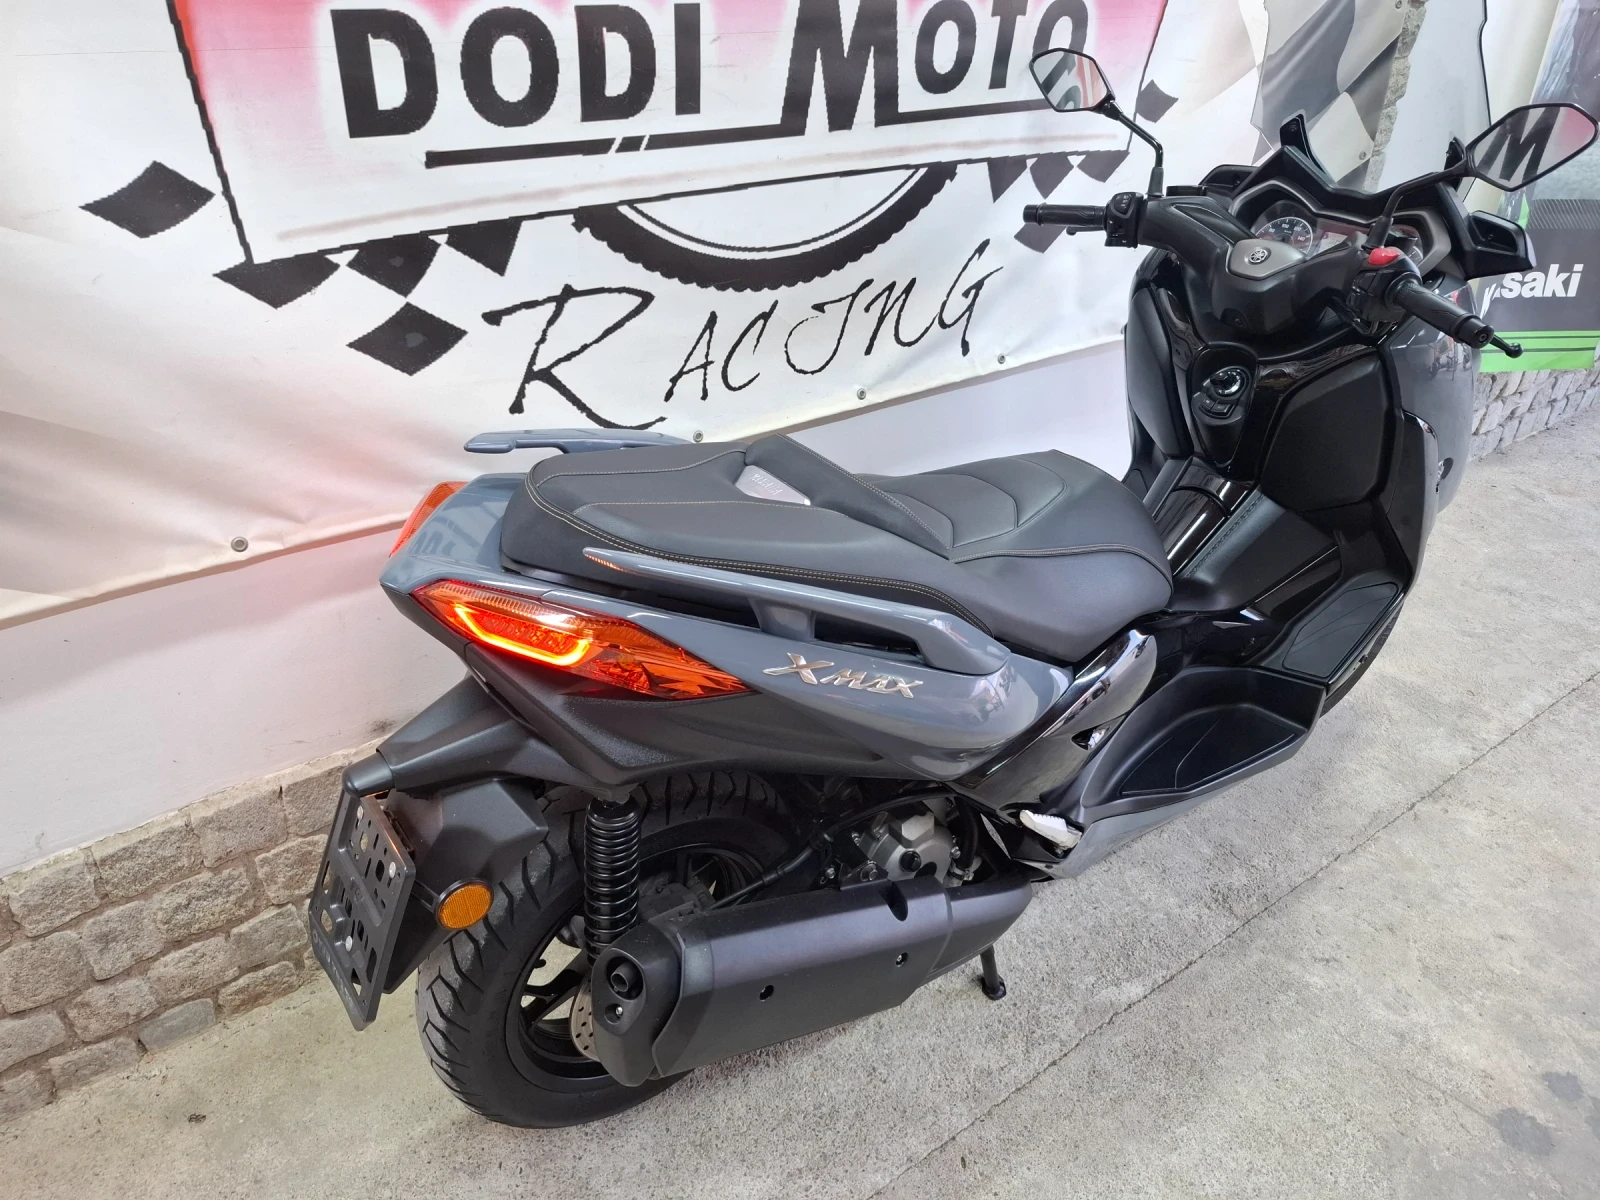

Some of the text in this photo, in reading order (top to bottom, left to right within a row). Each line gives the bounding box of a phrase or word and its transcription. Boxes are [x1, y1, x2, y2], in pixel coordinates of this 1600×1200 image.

[330, 3, 701, 138] DODI
[481, 238, 1004, 430] RACING
[1498, 263, 1585, 299] saki
